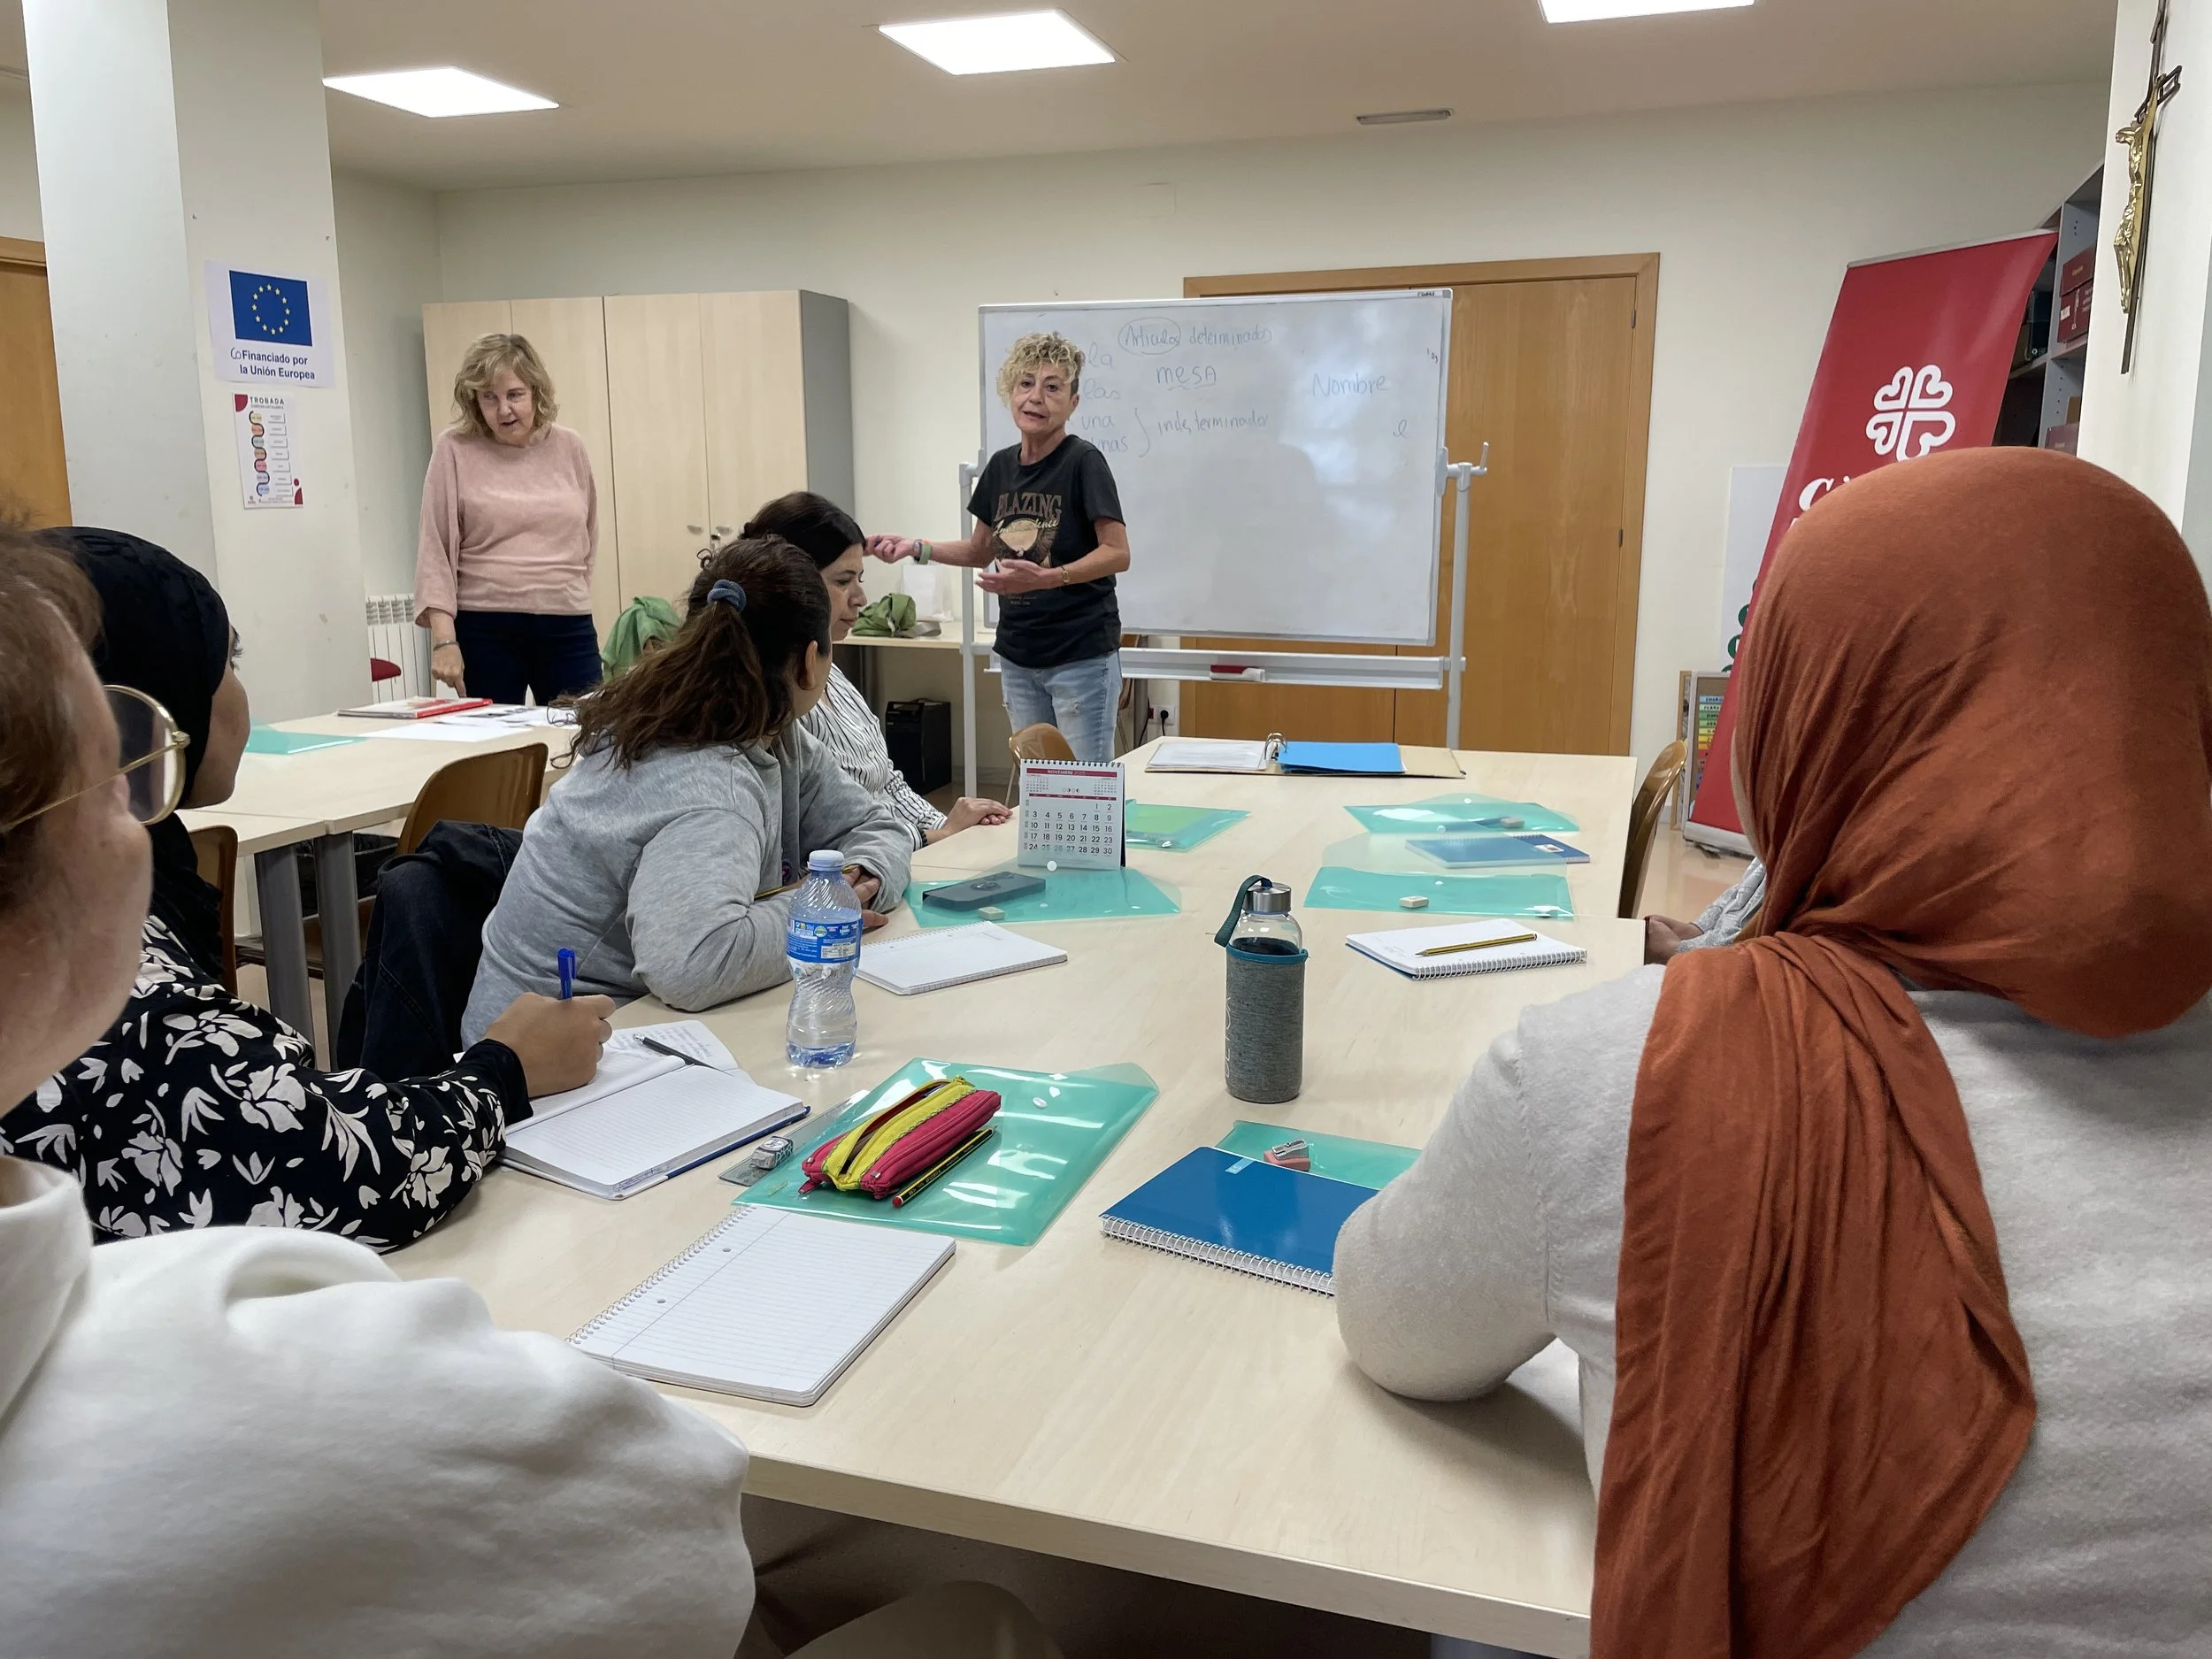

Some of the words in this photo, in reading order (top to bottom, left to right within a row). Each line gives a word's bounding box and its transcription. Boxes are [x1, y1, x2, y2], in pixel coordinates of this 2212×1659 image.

[1188, 324, 1272, 346] determinados
[230, 347, 290, 364] CoFinanciado
[292, 356, 308, 366] por
[1087, 342, 1115, 370] la
[240, 364, 248, 374] la
[250, 365, 276, 377] Unión
[278, 367, 315, 380] Europea
[1082, 378, 1121, 399] las
[1312, 372, 1389, 397] Nombre
[250, 396, 285, 405] TROBADA
[1080, 414, 1115, 431] una
[994, 491, 1063, 523] BLAZING
